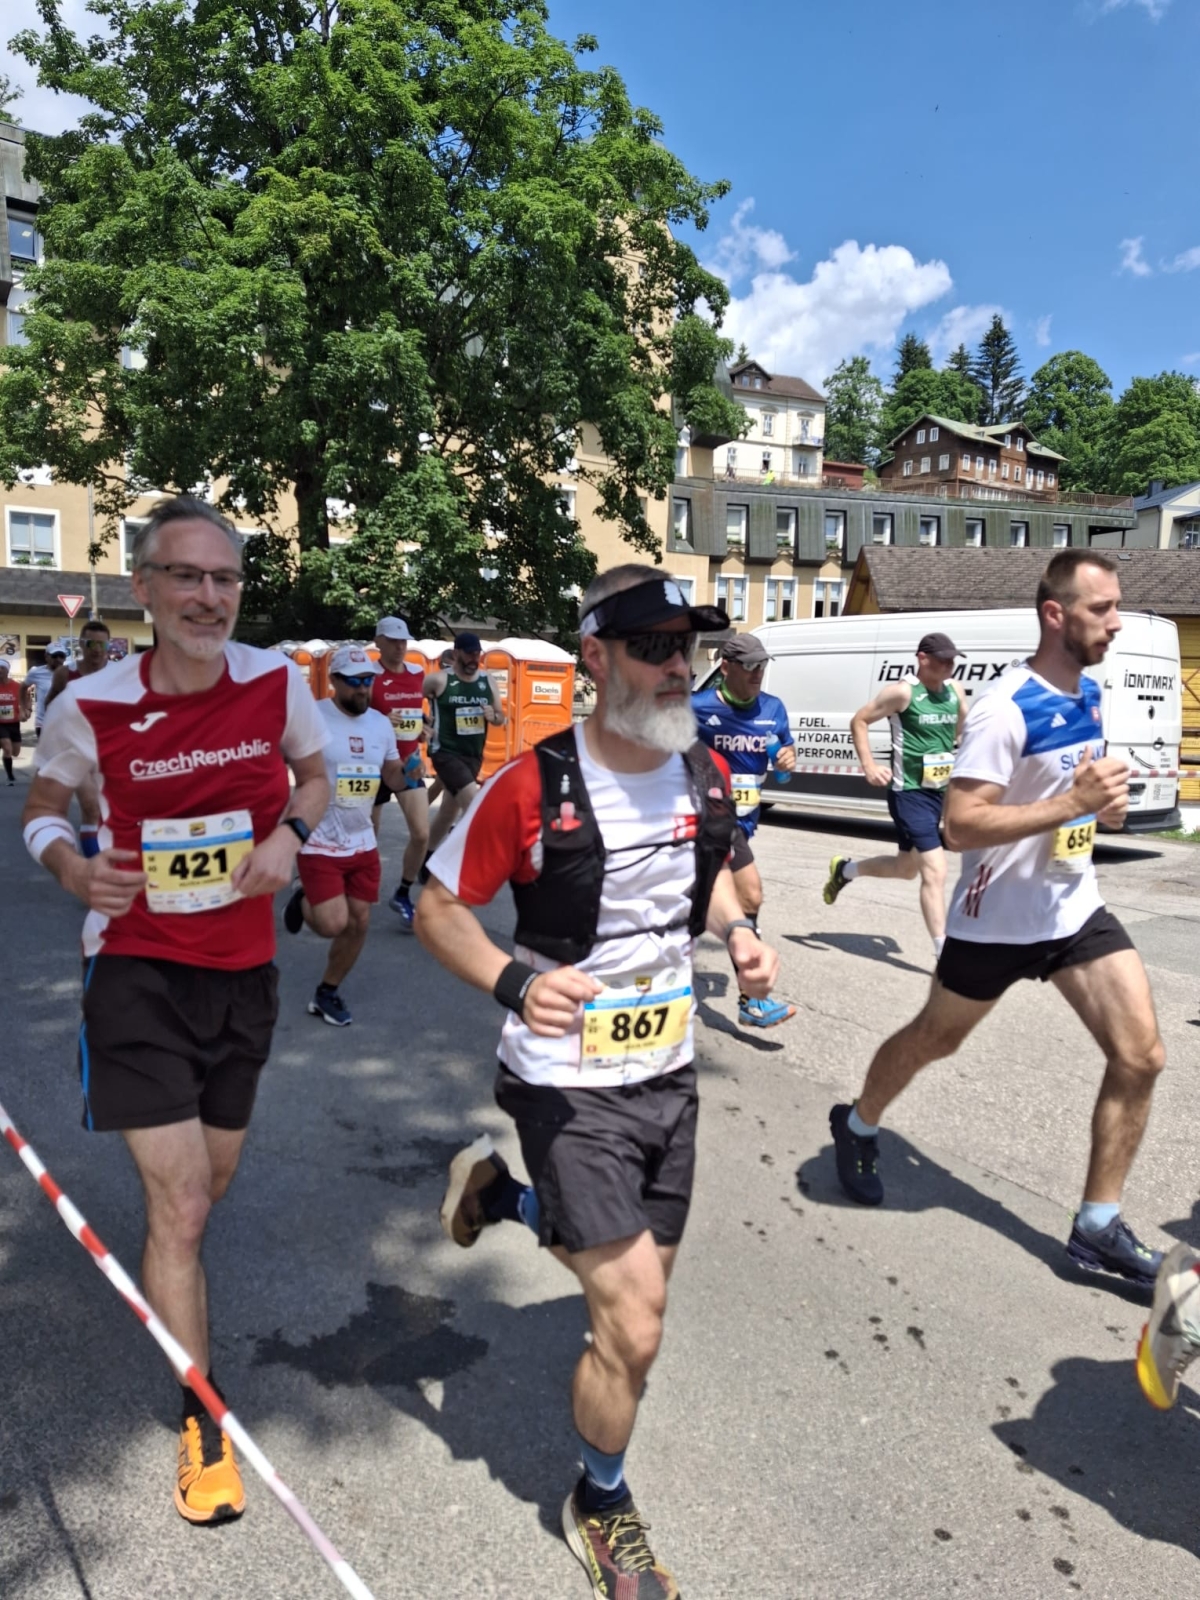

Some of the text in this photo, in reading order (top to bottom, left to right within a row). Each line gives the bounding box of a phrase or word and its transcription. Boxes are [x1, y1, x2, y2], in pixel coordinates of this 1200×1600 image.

[534, 685, 559, 694] Boels
[448, 695, 489, 705] IRELAND
[400, 719, 416, 730] 849
[464, 716, 479, 726] 110
[799, 717, 831, 728] FUEL.
[713, 735, 768, 752] FRANCE
[129, 738, 271, 778] CzechRepublic
[797, 748, 858, 760] PERFORM.
[348, 780, 371, 792] 125
[1067, 825, 1092, 850] 654
[169, 846, 228, 880] 421
[610, 1005, 670, 1042] 867
